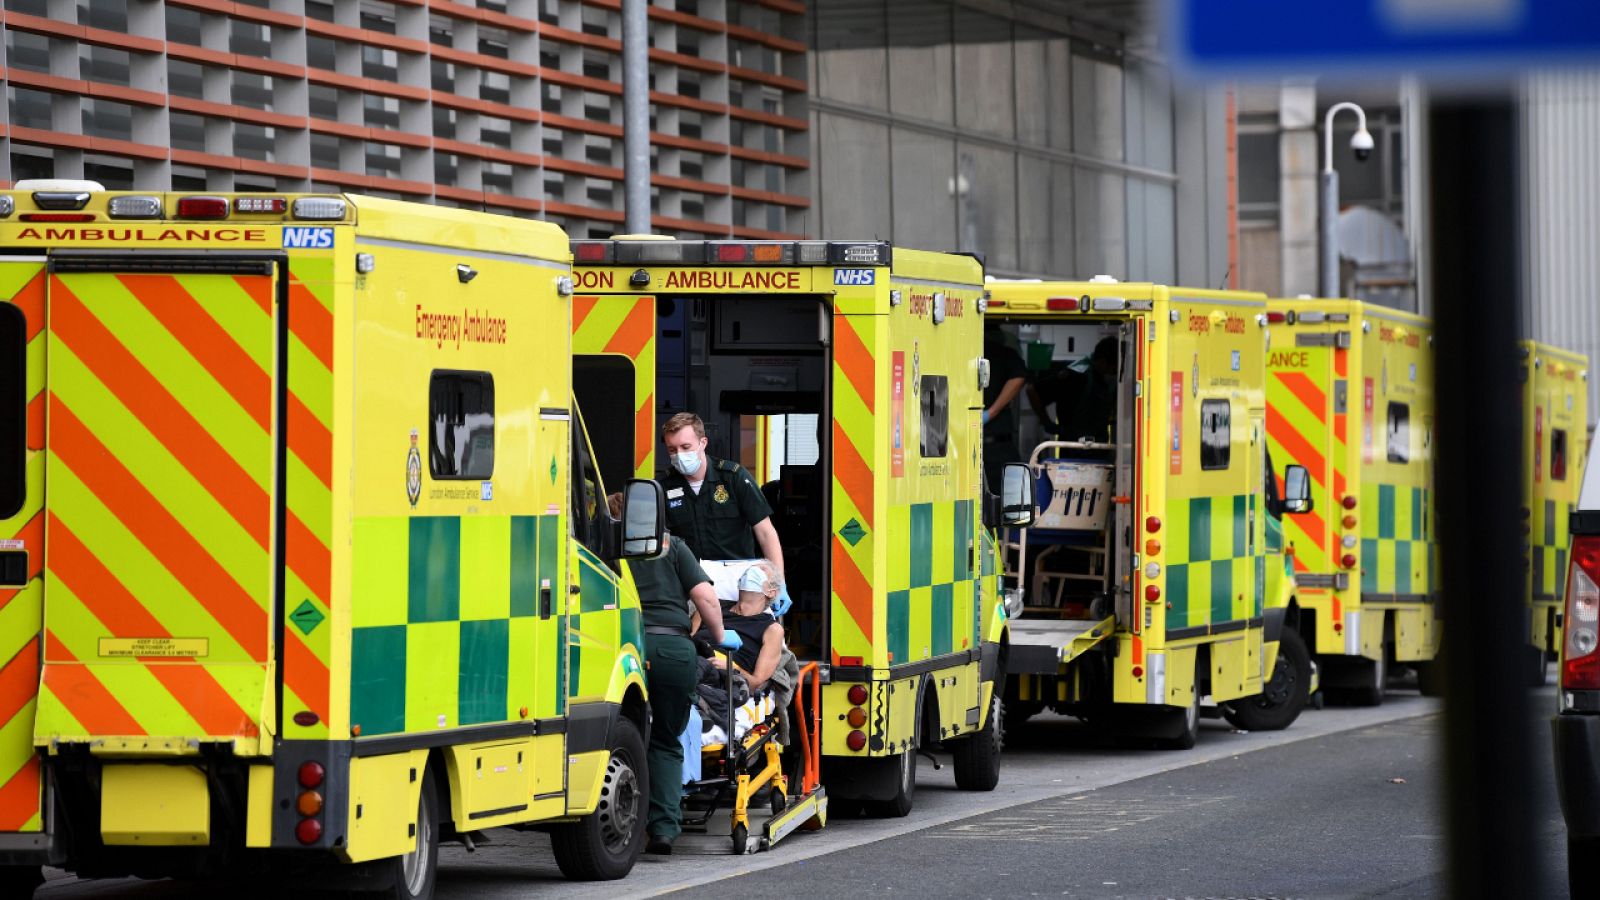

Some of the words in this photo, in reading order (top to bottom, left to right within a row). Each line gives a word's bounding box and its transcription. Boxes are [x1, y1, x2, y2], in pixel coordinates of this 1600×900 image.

[16, 228, 266, 241] AMBULANCE
[283, 228, 332, 246] NHS
[665, 271, 800, 289] AMBULANCE
[835, 270, 873, 284] NHS
[416, 304, 461, 350] Emergency
[463, 308, 506, 344] Ambulance
